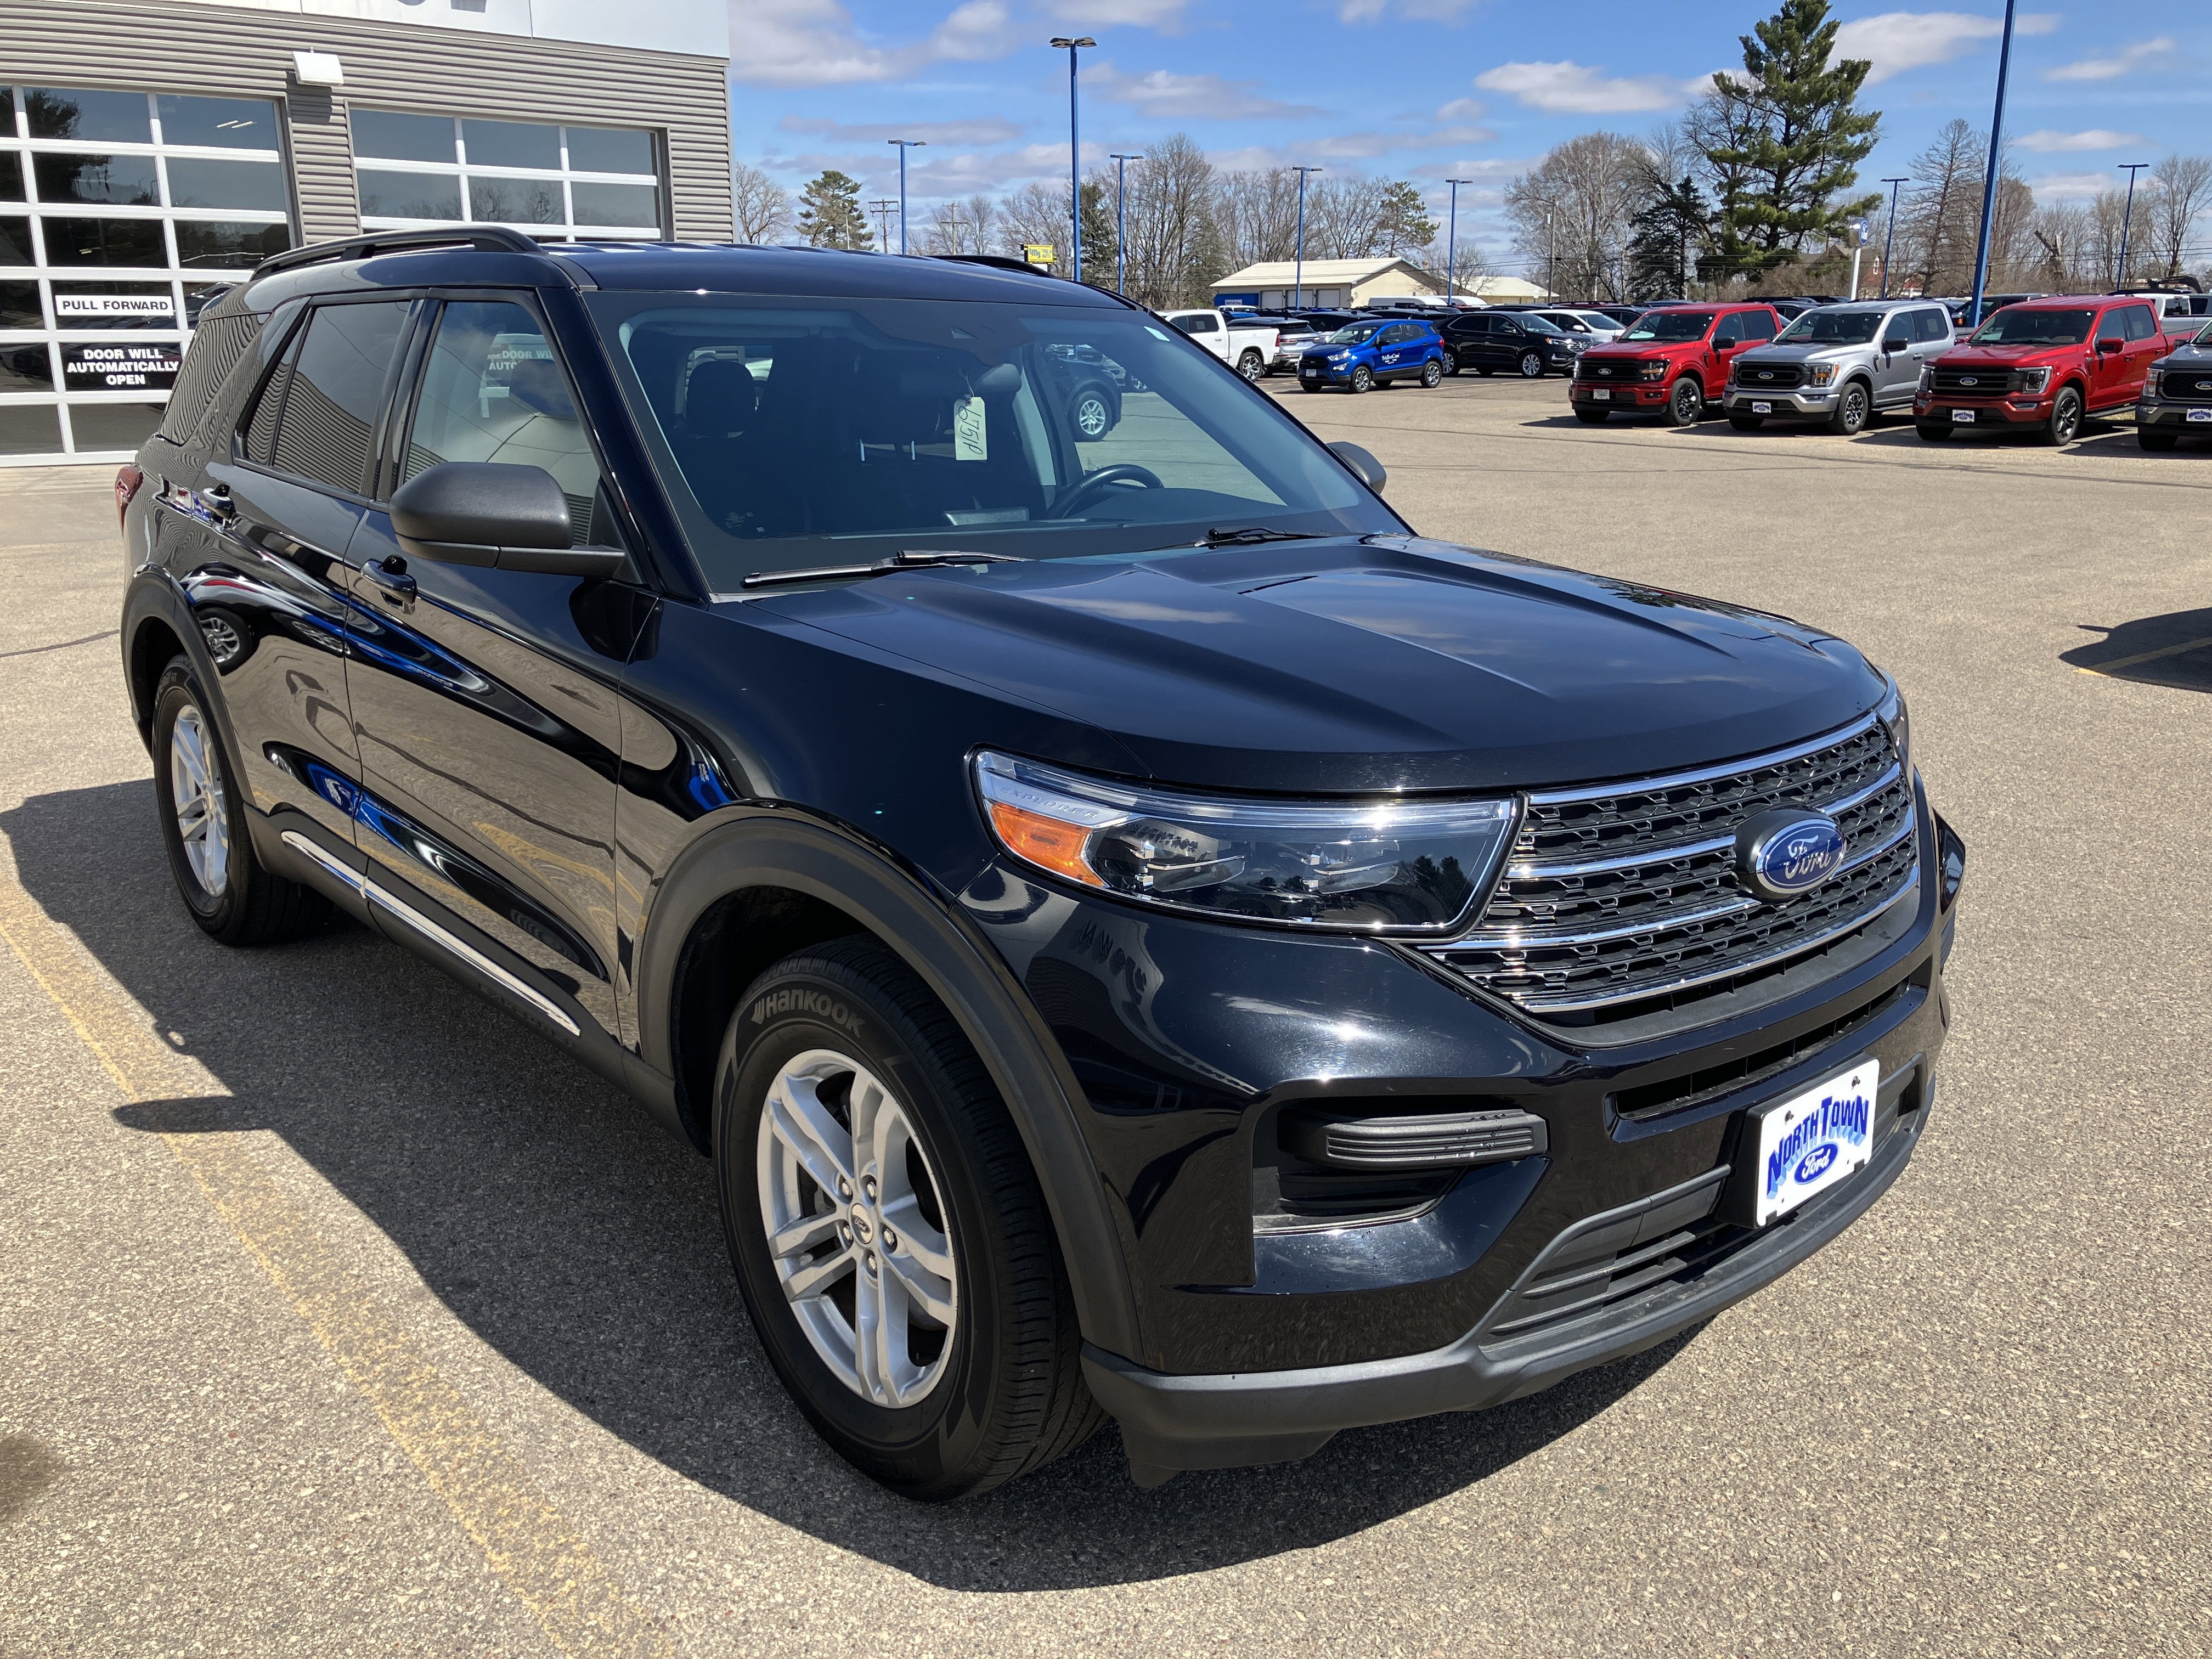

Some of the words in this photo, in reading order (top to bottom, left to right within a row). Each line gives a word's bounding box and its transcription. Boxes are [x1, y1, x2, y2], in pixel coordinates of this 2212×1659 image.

[62, 300, 98, 310] PULL
[103, 300, 169, 310] FORWARD
[83, 348, 125, 360] DOOR
[128, 348, 163, 359] WILL
[502, 351, 532, 359] DOOR
[67, 361, 179, 373] AUTOMATICALLY
[105, 374, 146, 386] OPEN
[958, 405, 984, 455] 6751P
[1000, 787, 1099, 819] EXPLORER
[1784, 834, 1832, 879] Ford
[1801, 1148, 1831, 1180] Ford
[854, 1217, 867, 1231] Ford
